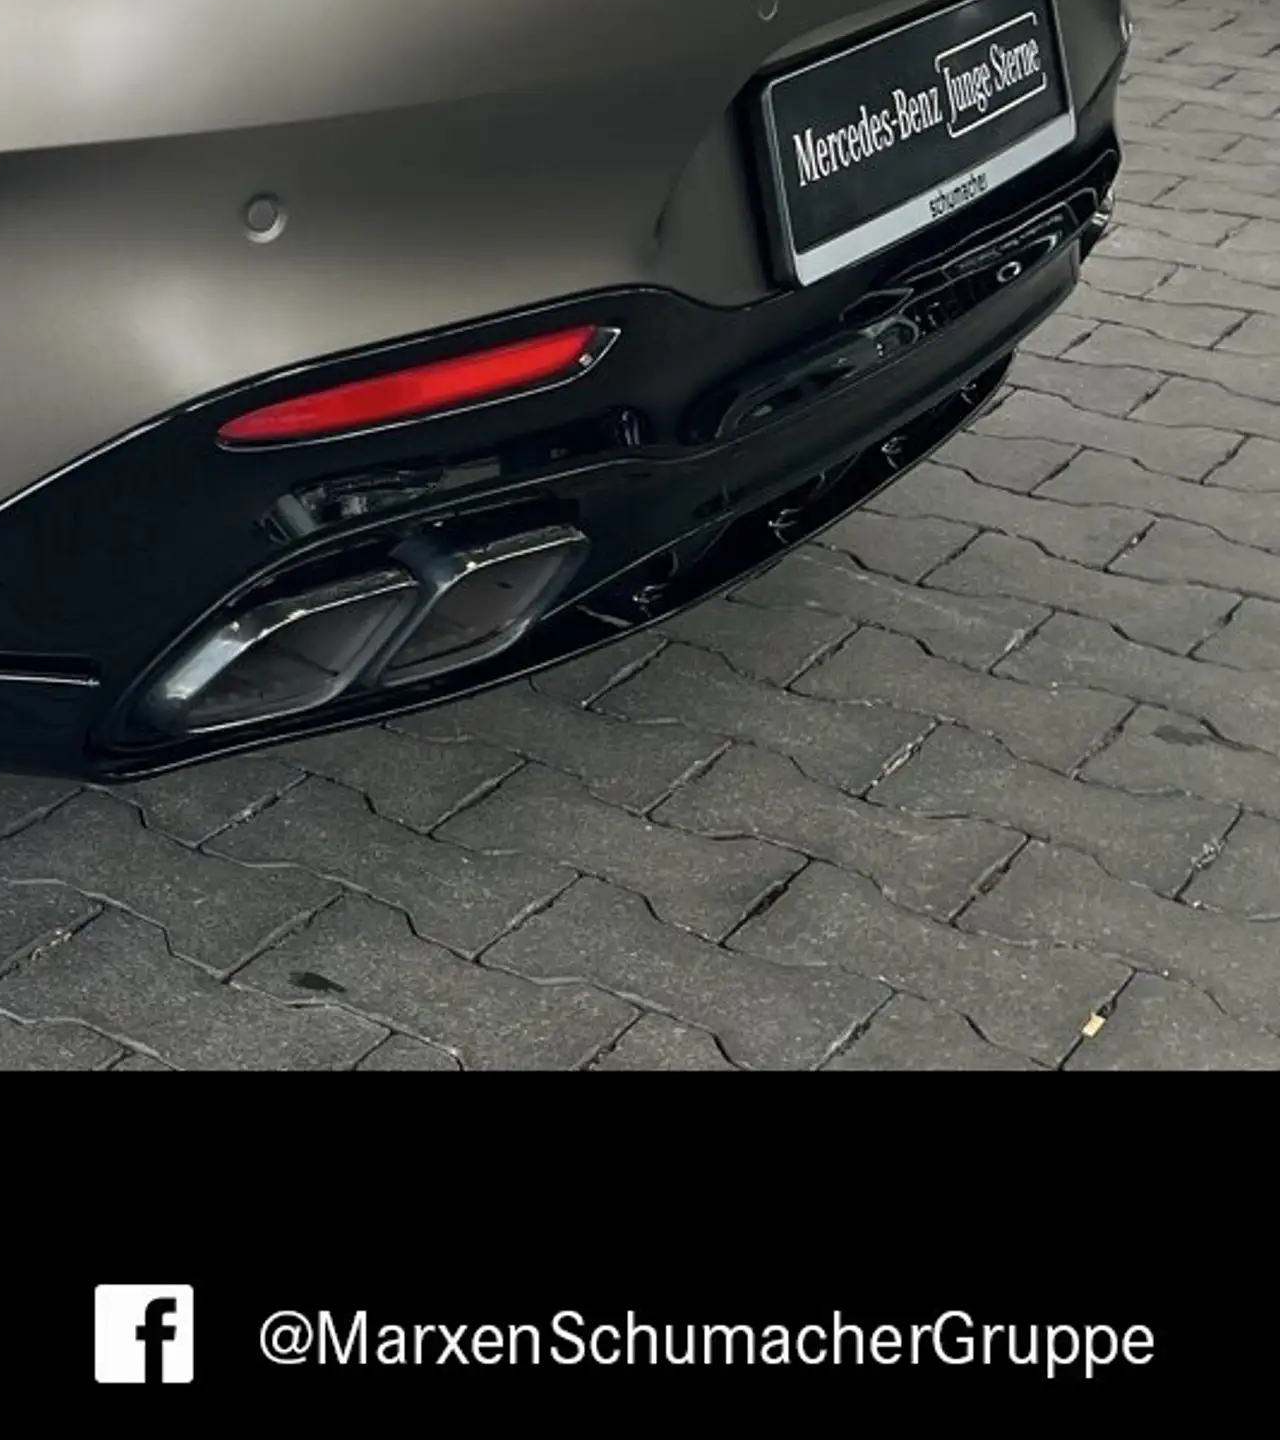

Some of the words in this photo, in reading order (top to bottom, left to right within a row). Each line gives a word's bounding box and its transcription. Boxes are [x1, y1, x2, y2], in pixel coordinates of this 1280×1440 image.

[793, 86, 943, 187] Mercedes-Benz
[943, 62, 994, 124] Junge
[989, 39, 1041, 92] Sterne
[929, 172, 989, 219] schumacher
